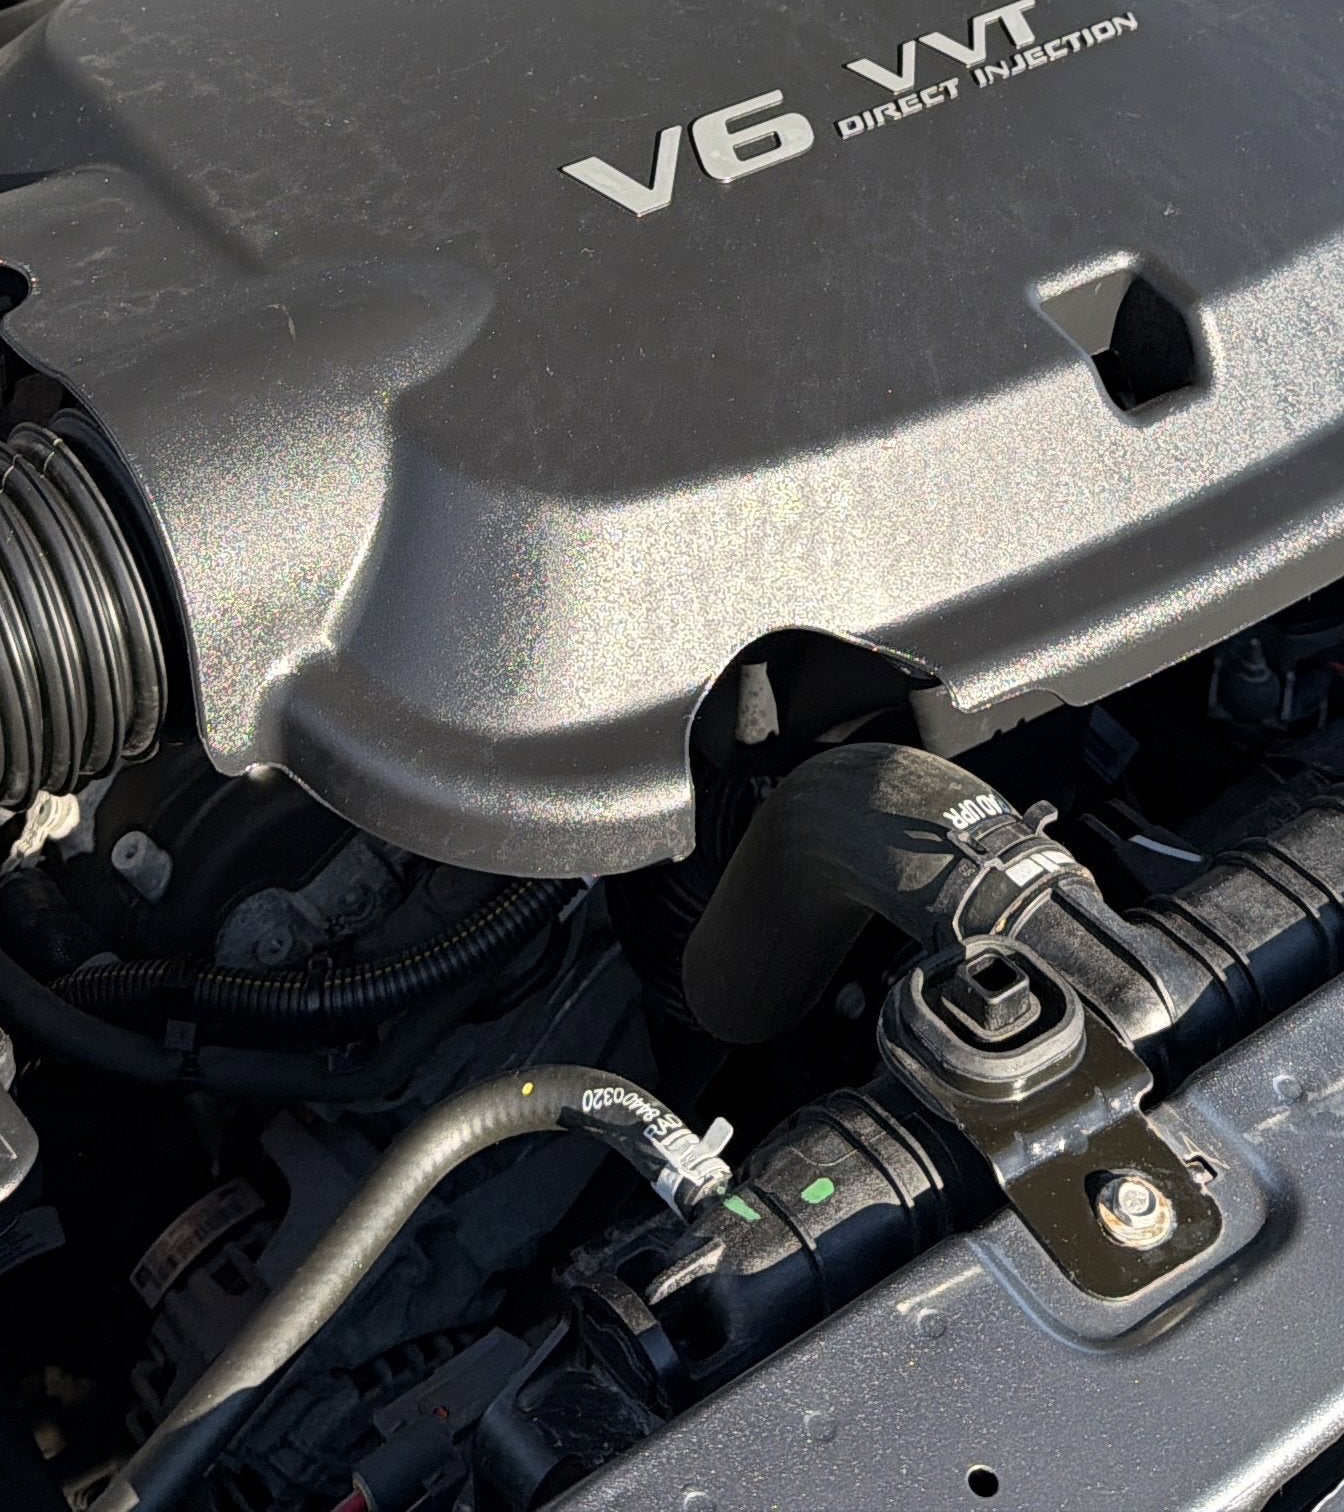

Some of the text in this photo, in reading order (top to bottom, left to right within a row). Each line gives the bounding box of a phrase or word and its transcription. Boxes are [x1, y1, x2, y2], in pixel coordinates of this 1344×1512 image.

[838, 11, 1139, 139] DIRECT INJECTION
[561, 89, 814, 216] V6
[942, 799, 987, 830] UPR
[581, 1086, 661, 1123] 84400320
[642, 1112, 684, 1142] RAD
